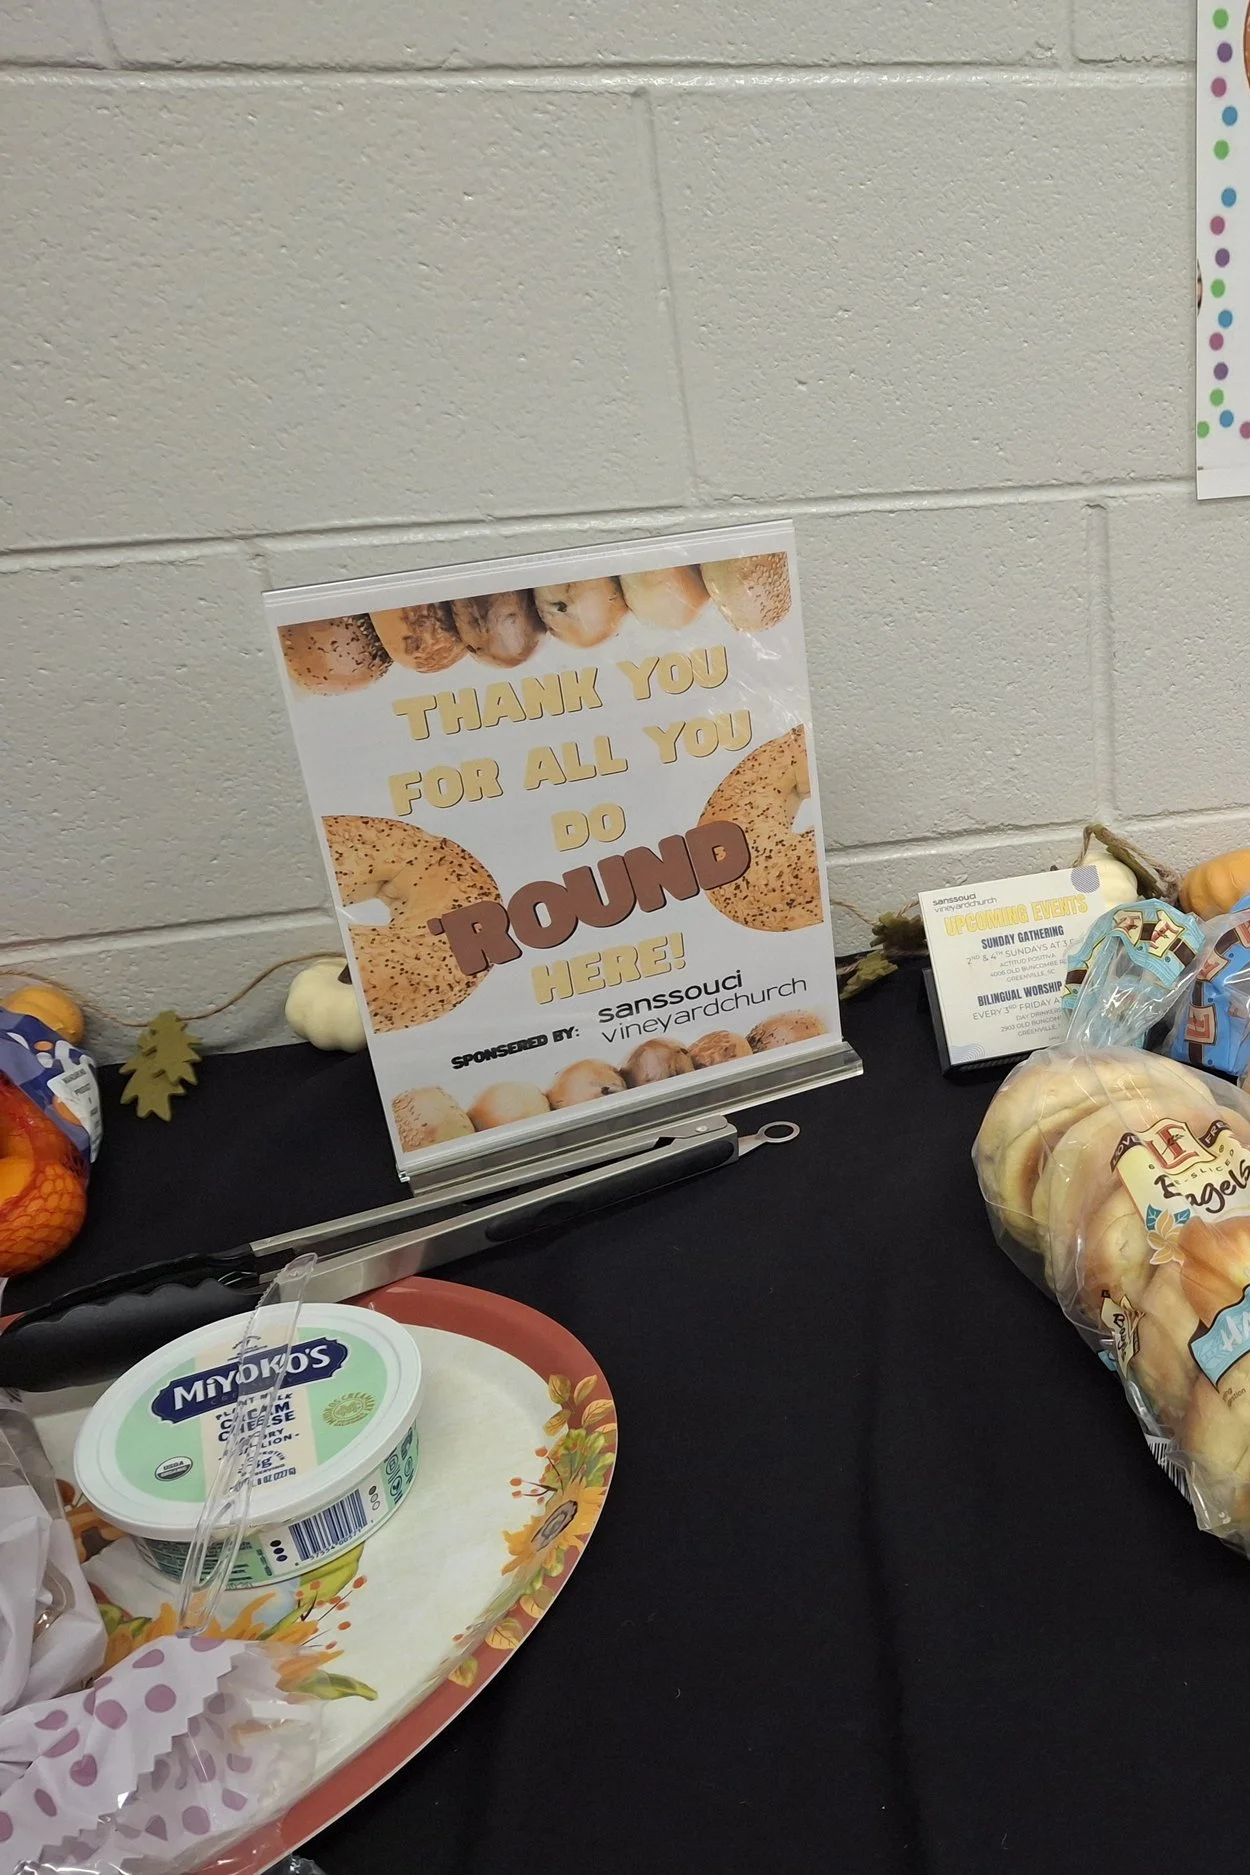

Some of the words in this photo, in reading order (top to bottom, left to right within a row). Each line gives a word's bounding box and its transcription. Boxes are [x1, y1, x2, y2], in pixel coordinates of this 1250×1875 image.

[392, 666, 603, 741] THANK
[617, 645, 730, 701] YOU
[388, 758, 504, 817] FOR
[523, 735, 629, 793] ALL
[643, 709, 753, 766] YOU
[550, 803, 628, 853] DO
[944, 903, 1030, 937] UPCOMING
[1031, 894, 1088, 921] EVENTS
[981, 931, 1019, 949] SUNDAY
[1018, 925, 1065, 943] GATHERING
[531, 932, 688, 1006] HERE!
[1005, 943, 1049, 958] SUNDAYS
[1050, 942, 1061, 950] AT
[598, 970, 743, 1023] sanssouci
[602, 977, 808, 1043] vineyardchurch
[973, 1009, 1002, 1020] EVERY
[1019, 1000, 1052, 1011] FRIDAY
[977, 991, 1022, 1006] BILINGUAL
[1023, 980, 1062, 997] WORSHIP
[451, 1033, 549, 1070] SPONSERED
[552, 1026, 580, 1044] BY:
